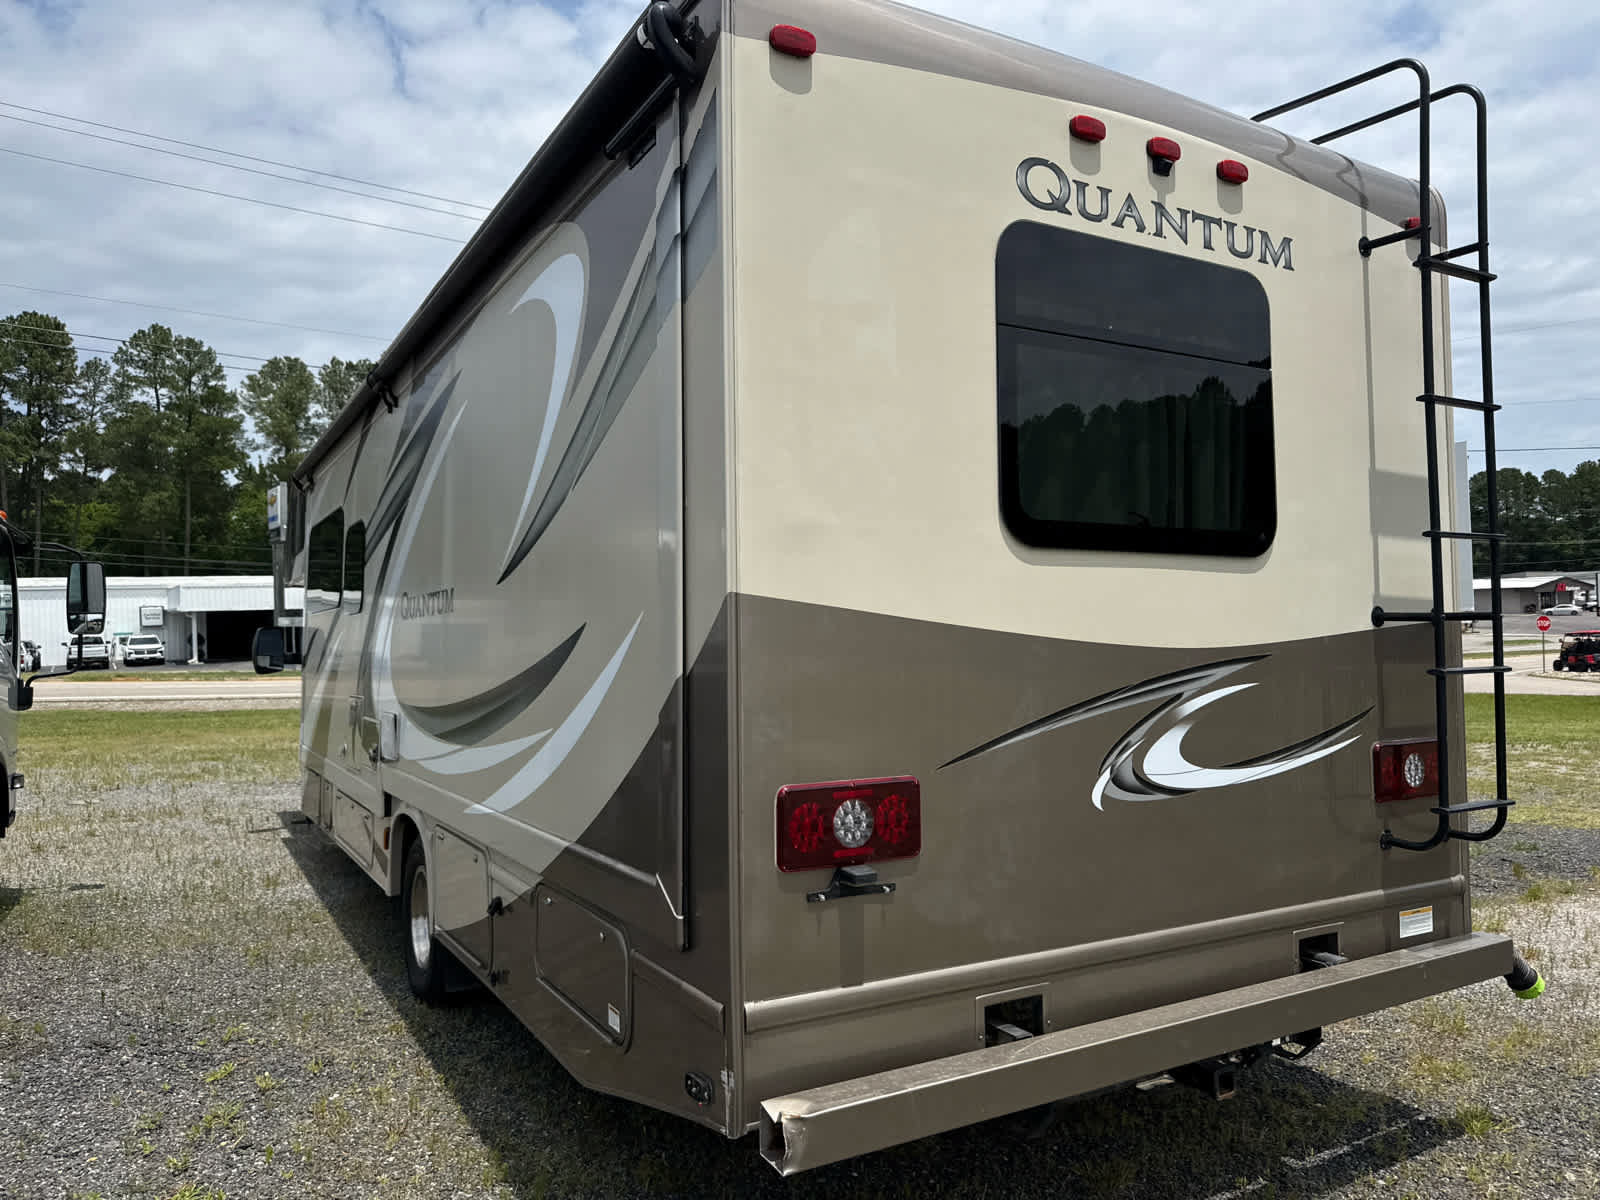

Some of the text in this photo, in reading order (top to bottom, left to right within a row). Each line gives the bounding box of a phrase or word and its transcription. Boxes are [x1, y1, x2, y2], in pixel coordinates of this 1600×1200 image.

[1015, 156, 1295, 271] QUANTUM
[400, 587, 455, 620] QUANTUM
[1537, 619, 1551, 627] STOP
